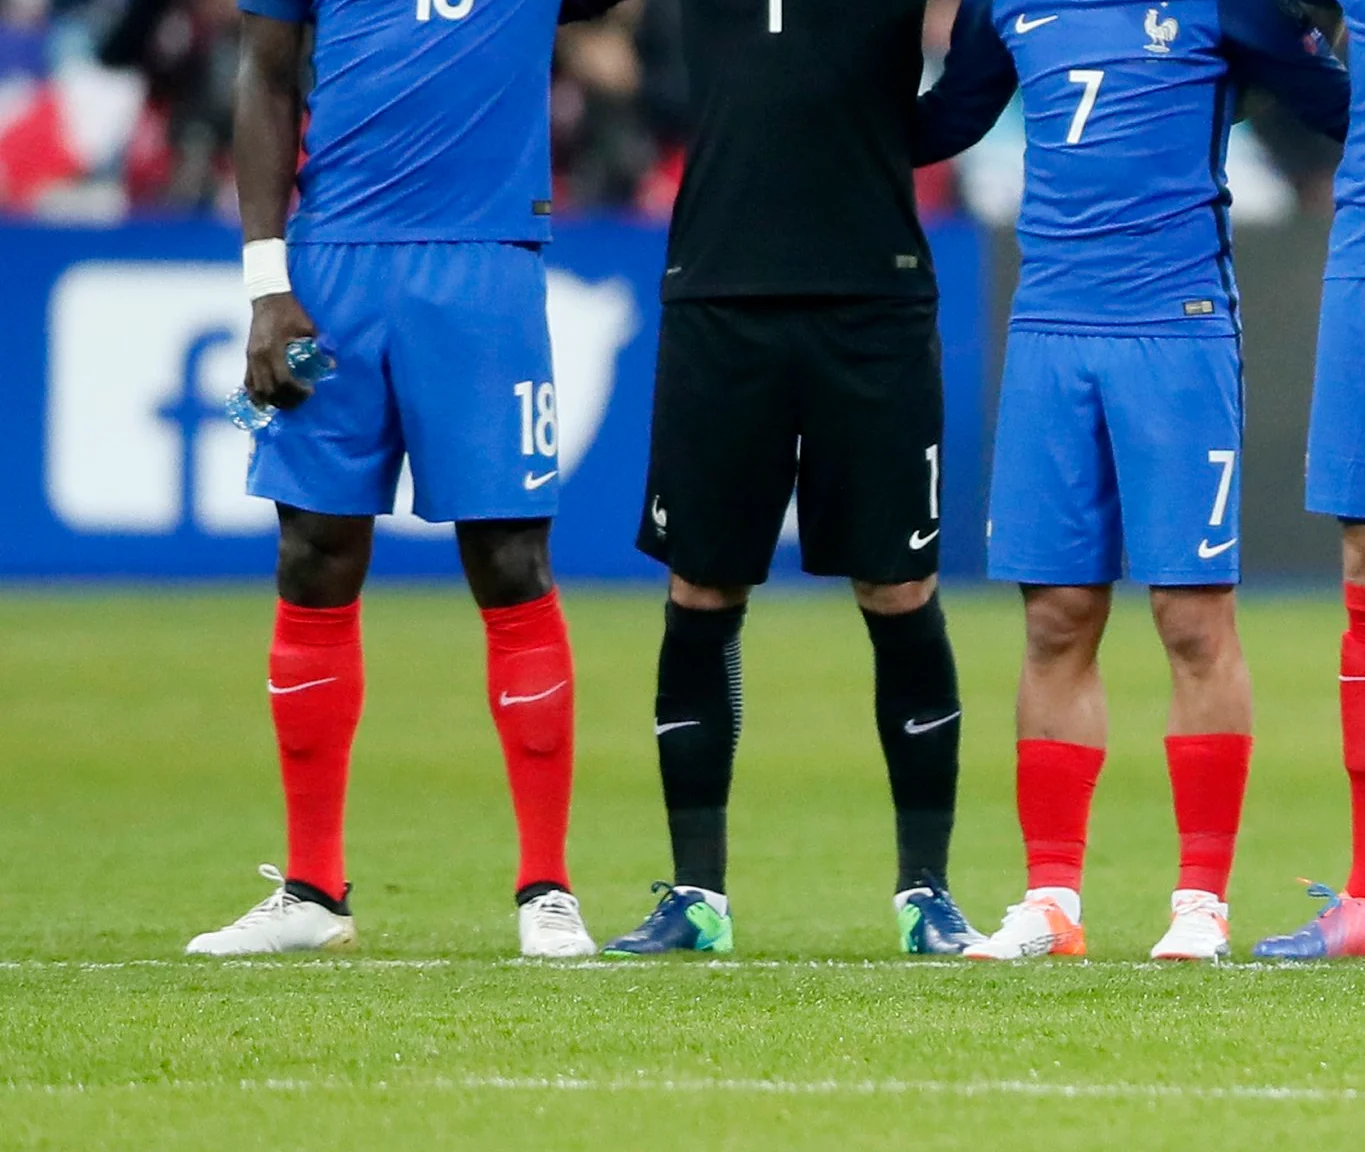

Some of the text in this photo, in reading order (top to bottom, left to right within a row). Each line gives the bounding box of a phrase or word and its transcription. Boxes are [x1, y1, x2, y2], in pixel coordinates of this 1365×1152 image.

[1066, 69, 1105, 145] 7
[513, 379, 560, 457] 18
[925, 444, 939, 519] 1
[1208, 450, 1236, 526] 7
